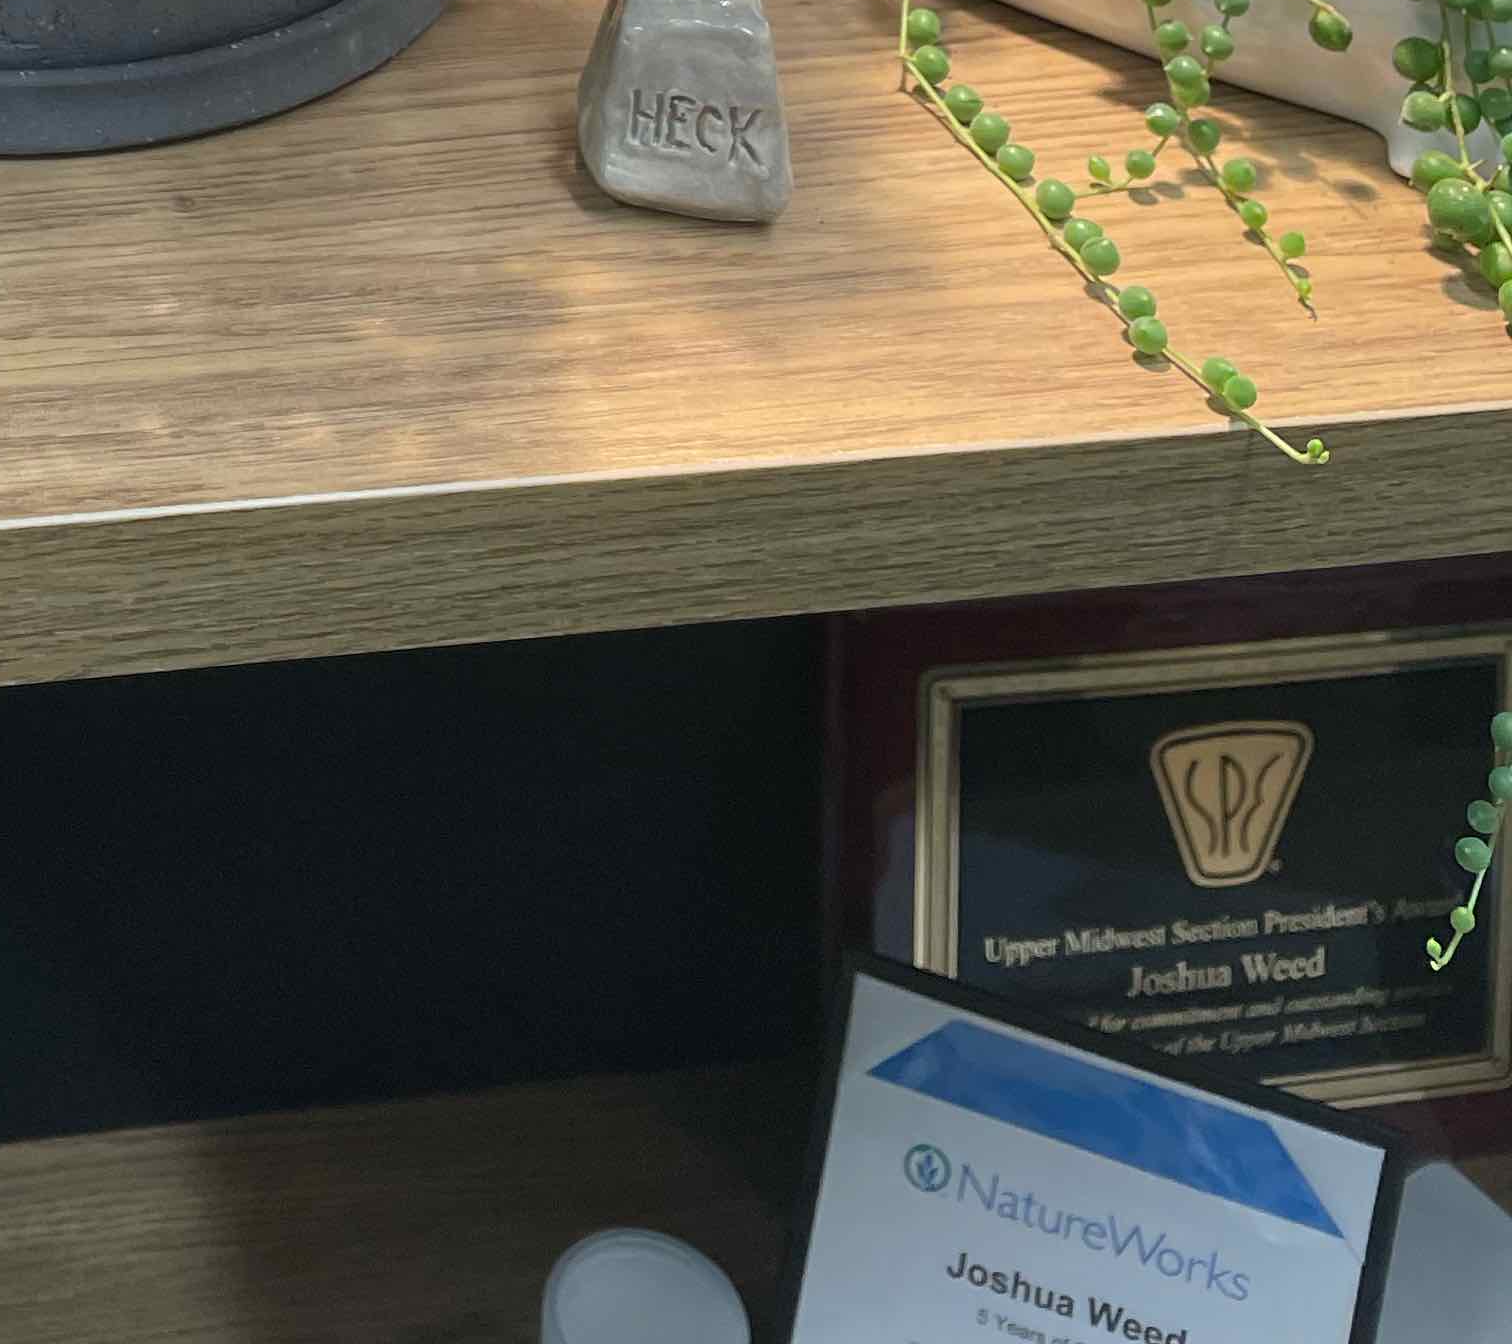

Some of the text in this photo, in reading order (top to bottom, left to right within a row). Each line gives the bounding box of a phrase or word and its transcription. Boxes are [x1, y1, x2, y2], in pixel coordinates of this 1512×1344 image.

[628, 88, 766, 168] HECK
[984, 936, 1059, 968] Upper
[1064, 923, 1168, 957] Midwest
[1171, 916, 1258, 945] Section
[1126, 943, 1326, 998] Joshua Weed
[957, 1163, 1251, 1301] NatureWorks
[946, 1252, 1075, 1318] Joshua
